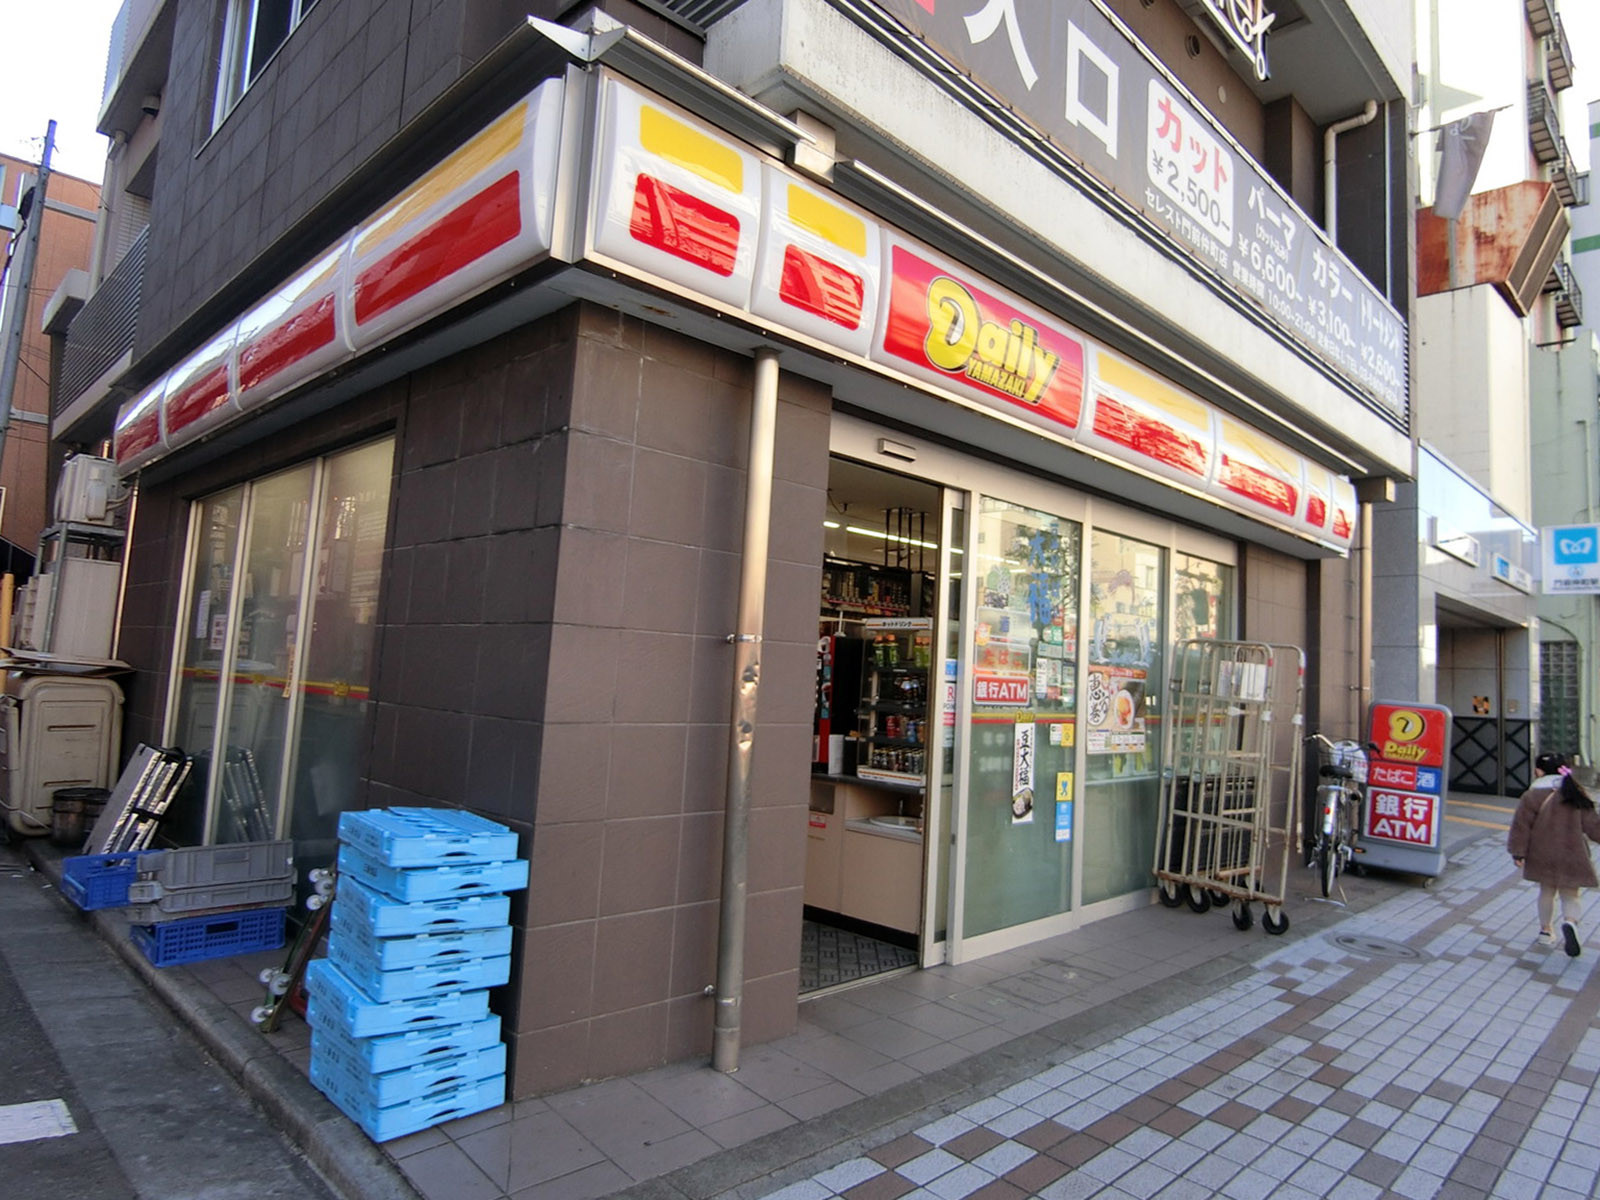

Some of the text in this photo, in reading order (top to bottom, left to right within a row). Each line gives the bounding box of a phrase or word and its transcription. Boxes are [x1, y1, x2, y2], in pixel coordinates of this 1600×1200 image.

[1157, 96, 1228, 192] カット
[1248, 186, 1296, 251] パーマ
[1312, 248, 1353, 302] カラー
[925, 275, 1060, 405] Daily
[966, 357, 1028, 398] YAMAZAKI
[976, 680, 1028, 700] 銀行ATM
[1385, 740, 1427, 762] Daily
[1373, 766, 1414, 785] たばこ
[1417, 771, 1435, 788] 酒
[1375, 793, 1428, 820] 銀行
[1373, 817, 1427, 842] ATM
